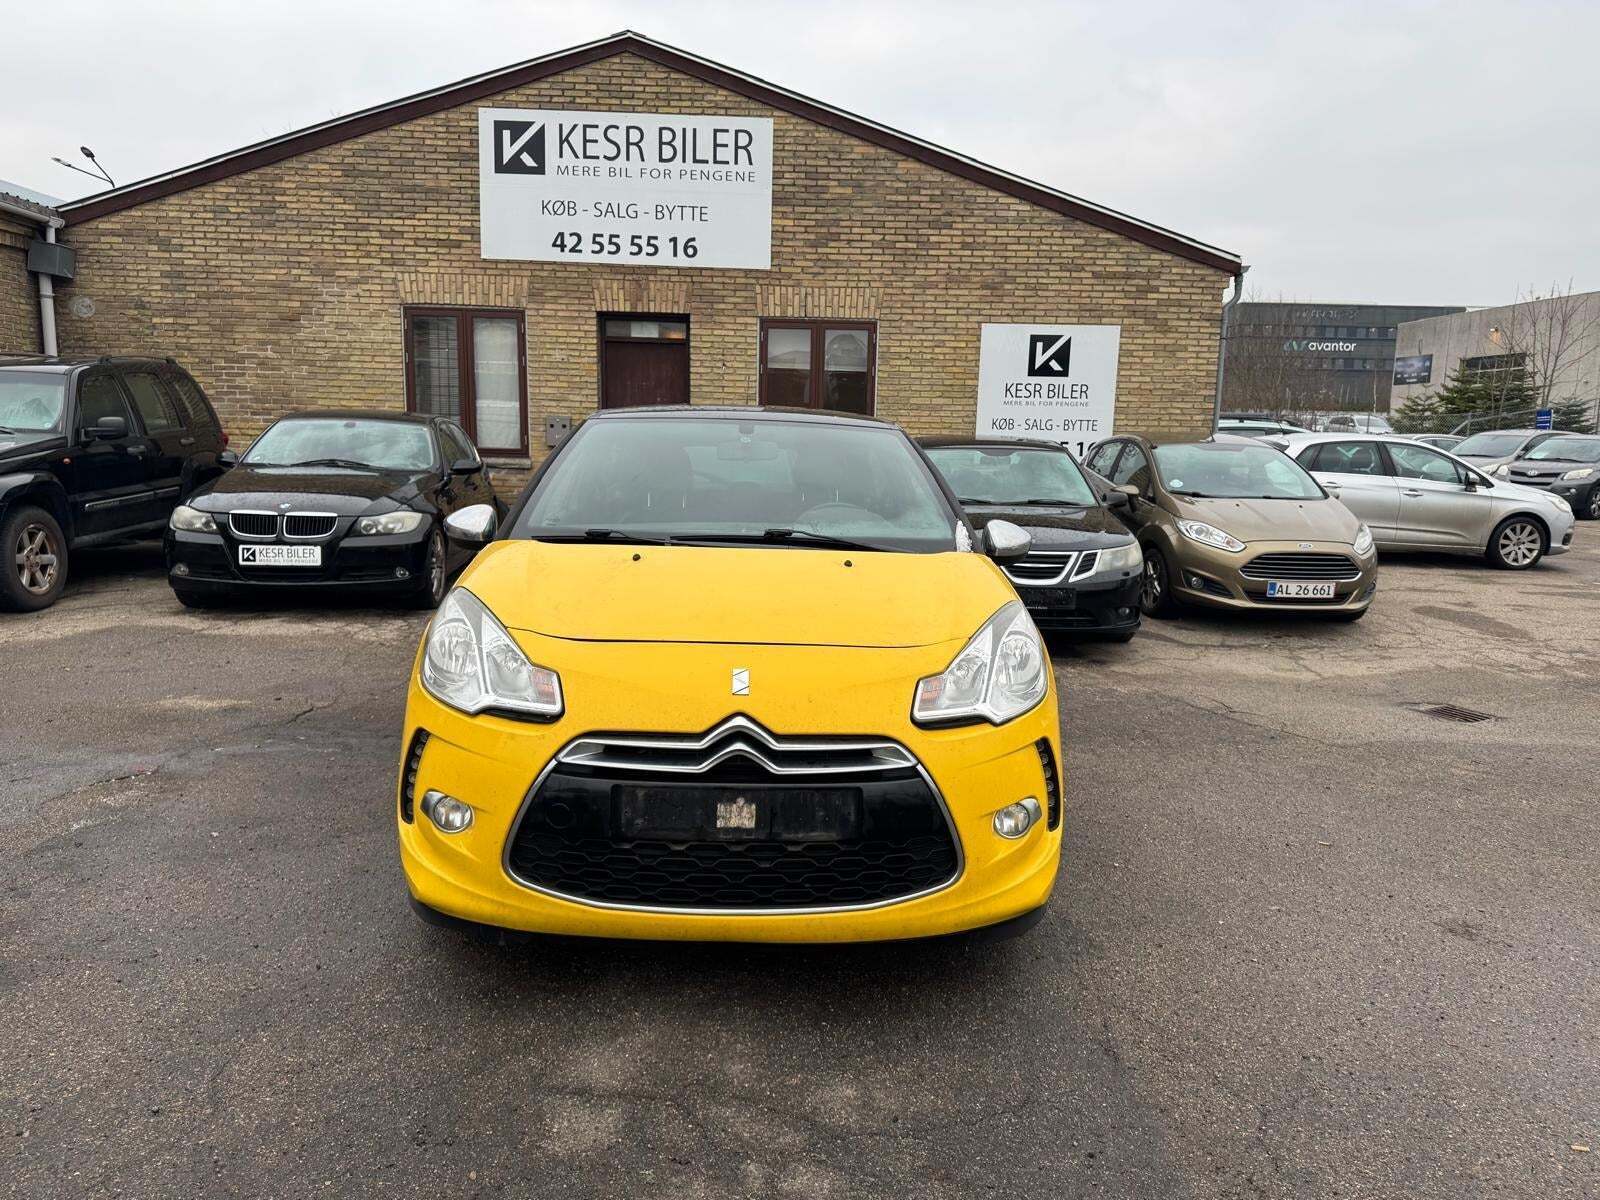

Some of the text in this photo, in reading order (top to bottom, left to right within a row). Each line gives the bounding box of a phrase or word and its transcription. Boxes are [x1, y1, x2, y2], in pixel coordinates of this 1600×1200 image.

[557, 122, 754, 166] KESR BILER
[556, 165, 756, 183] MERE BIL FOR PENGENE
[541, 199, 577, 217] KØB
[593, 202, 639, 219] SALG
[655, 204, 709, 222] BYTTE
[551, 231, 698, 258] 42 55 55 16
[1308, 341, 1357, 352] avantor
[1004, 382, 1089, 400] KESR BILER
[991, 418, 1015, 431] KØB
[1024, 418, 1053, 431] SALG
[1063, 419, 1098, 432] BYTTE
[259, 547, 316, 559] KESR BILER
[1276, 584, 1332, 596] AL 26 661
